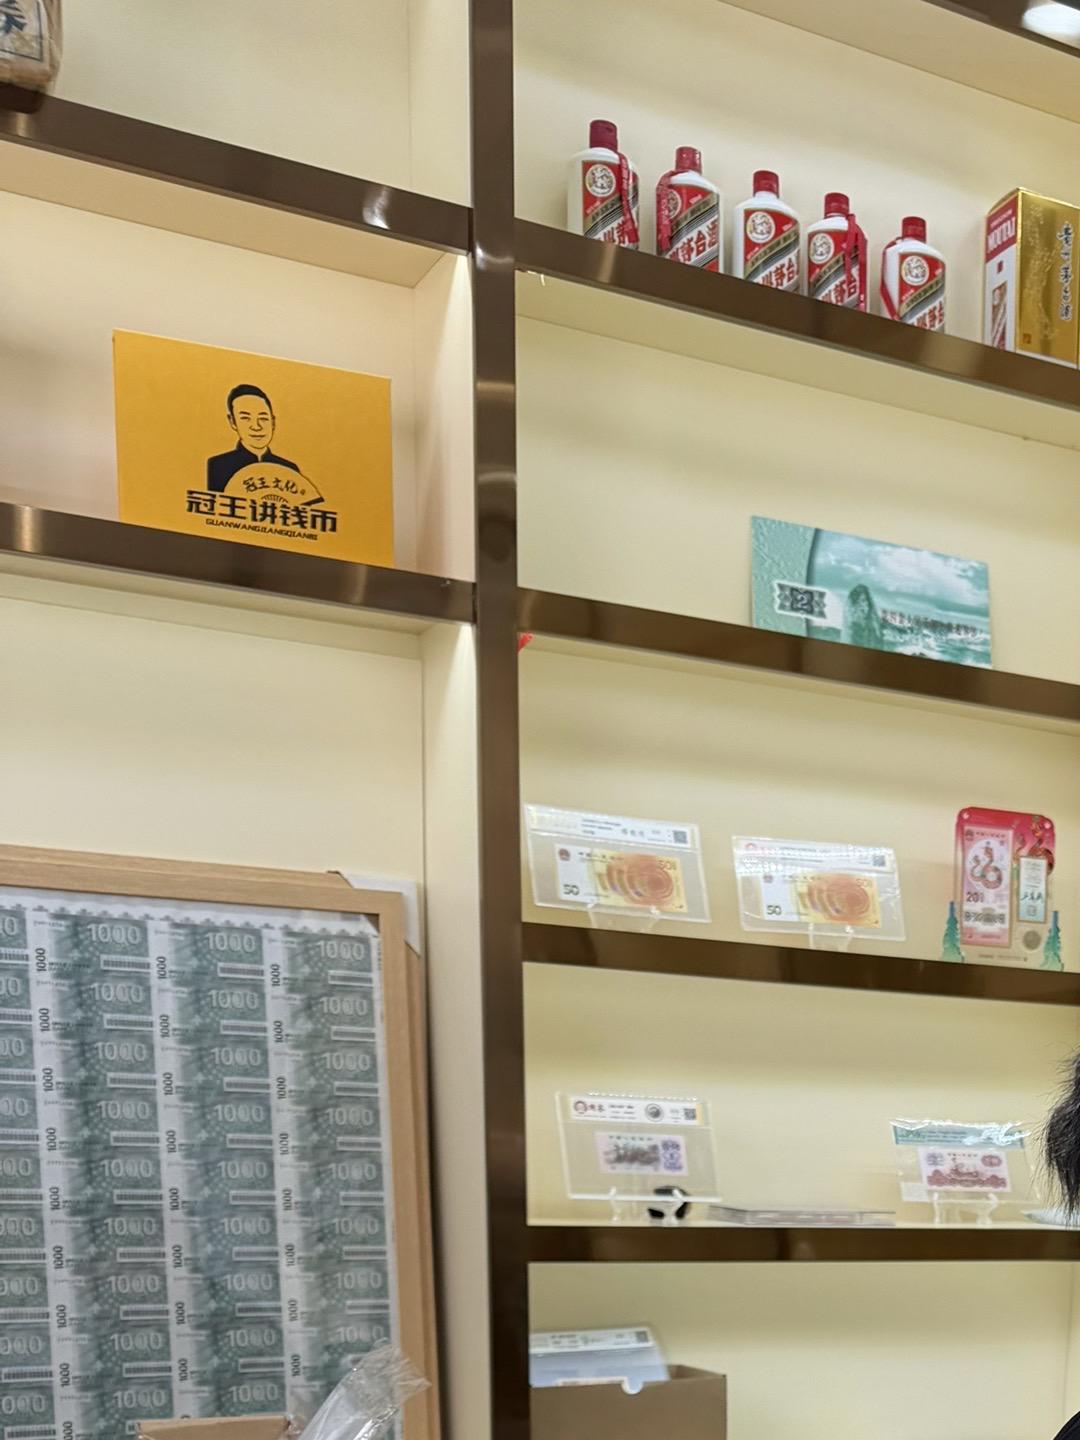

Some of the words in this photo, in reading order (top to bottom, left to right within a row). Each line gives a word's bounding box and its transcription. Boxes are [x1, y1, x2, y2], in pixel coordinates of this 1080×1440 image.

[186, 490, 338, 532] 冠王讲钱币
[563, 884, 580, 896] 50
[767, 905, 782, 916] 50
[88, 923, 140, 944] 1000
[205, 932, 256, 951] 1000
[35, 948, 46, 972] 1000
[317, 941, 365, 960] 1000
[157, 956, 167, 980] 1000
[270, 964, 281, 987] 1000
[91, 983, 143, 1003] 1000
[208, 990, 259, 1009] 1000
[319, 997, 368, 1016] 1000
[39, 1008, 50, 1032] 1000
[159, 1015, 170, 1038] 1000
[273, 1020, 283, 1043] 1000
[95, 1042, 147, 1061] 1000
[211, 1047, 261, 1066] 1000
[322, 1052, 370, 1071] 1000
[43, 1068, 53, 1092] 1000
[163, 1072, 173, 1096] 1000
[276, 1076, 287, 1100] 1000
[97, 1100, 150, 1119] 1000
[214, 1104, 264, 1122] 1000
[326, 1108, 374, 1126] 1000
[46, 1127, 56, 1151] 1000
[166, 1130, 176, 1153] 1000
[279, 1133, 290, 1155] 1000
[101, 1158, 153, 1177] 1000
[217, 1161, 267, 1179] 1000
[329, 1163, 377, 1181] 1000
[49, 1186, 60, 1210] 1000
[169, 1188, 180, 1211] 1000
[282, 1189, 292, 1211] 1000
[104, 1217, 157, 1236] 1000
[221, 1217, 270, 1235] 1000
[333, 1217, 379, 1235] 1000
[53, 1245, 64, 1269] 1000
[172, 1245, 183, 1268] 1000
[285, 1244, 295, 1267] 1000
[107, 1275, 160, 1293] 1000
[224, 1273, 273, 1291] 1000
[334, 1271, 382, 1289] 1000
[56, 1304, 67, 1328] 1000
[175, 1302, 185, 1325] 1000
[288, 1300, 298, 1322] 1000
[110, 1332, 163, 1351] 1000
[226, 1329, 276, 1347] 1000
[337, 1326, 384, 1344] 1000
[59, 1363, 70, 1387] 1000
[178, 1358, 188, 1381] 1000
[291, 1354, 301, 1376] 1000
[113, 1389, 166, 1409] 1000
[229, 1384, 278, 1402] 1000
